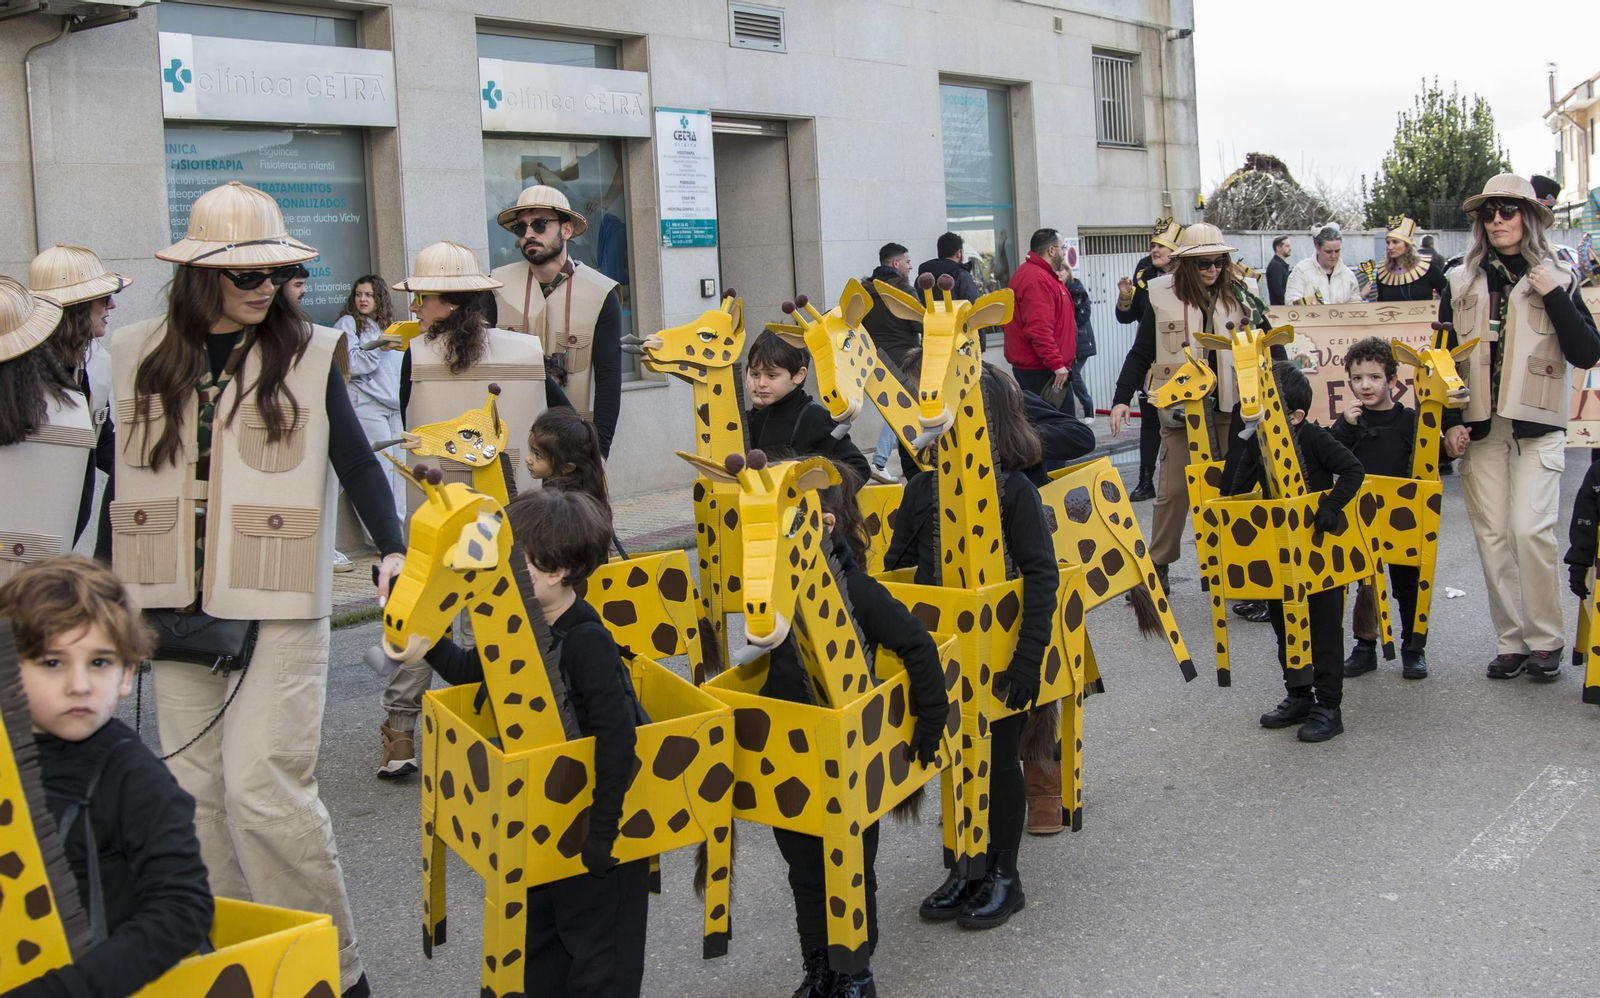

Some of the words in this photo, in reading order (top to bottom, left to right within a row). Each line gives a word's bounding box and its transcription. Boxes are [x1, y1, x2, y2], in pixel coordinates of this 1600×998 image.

[199, 67, 293, 97] clínica
[305, 71, 386, 101] CETRA
[507, 87, 576, 112] clínica
[583, 90, 644, 116] CETRA
[673, 130, 697, 141] CETRA
[259, 145, 299, 158] Esguinces
[170, 159, 243, 171] FISIOTERAPIA
[260, 159, 307, 171] Fisioterapia
[308, 160, 335, 171] infantil
[196, 176, 218, 185] seca
[256, 182, 332, 194] TRATAMIENTOS
[296, 215, 312, 223] con
[313, 212, 338, 223] ducha
[339, 212, 360, 225] Vichy
[314, 281, 352, 292] laborales
[315, 295, 326, 305] de
